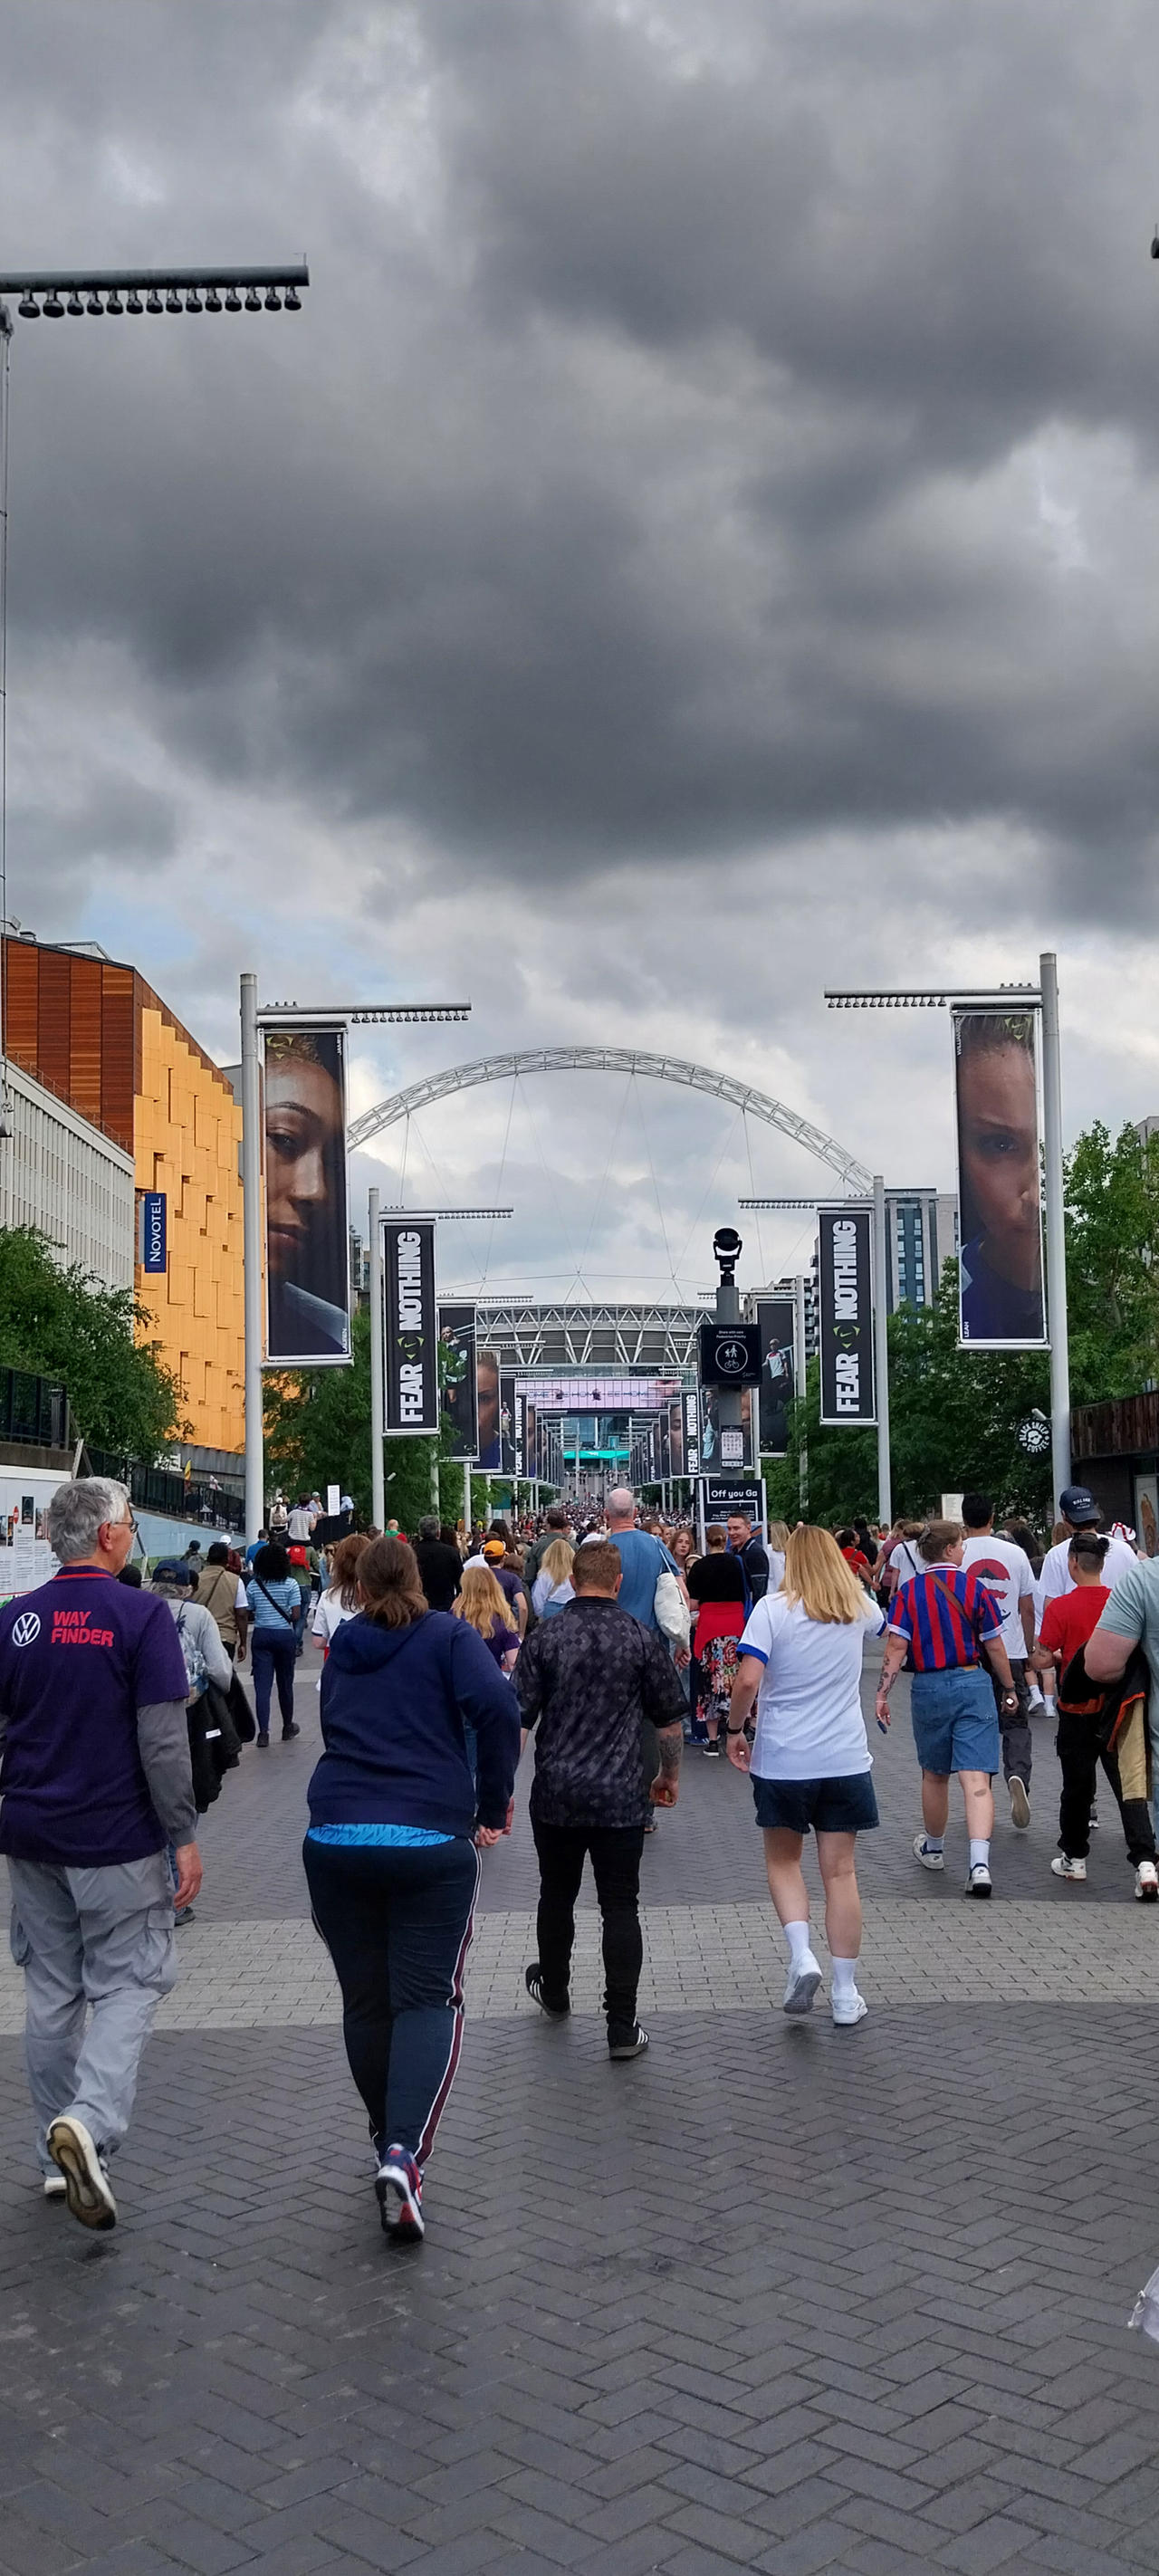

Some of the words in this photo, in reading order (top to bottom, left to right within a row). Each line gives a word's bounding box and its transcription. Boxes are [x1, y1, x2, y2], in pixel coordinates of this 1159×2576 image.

[149, 1197, 162, 1262] NOVOTEL
[397, 1231, 423, 1331] NOTHING
[832, 1221, 858, 1320] NOTHING
[399, 1363, 424, 1422] FEAR
[836, 1353, 860, 1412] FEAR
[686, 1394, 697, 1436] NOTHING
[1031, 1422, 1049, 1434] SHEEP
[687, 1448, 698, 1473] FEAR
[711, 1489, 727, 1498] Off
[728, 1491, 744, 1499] you
[51, 1628, 115, 1648] FINDER
[53, 1611, 91, 1626] WAY
